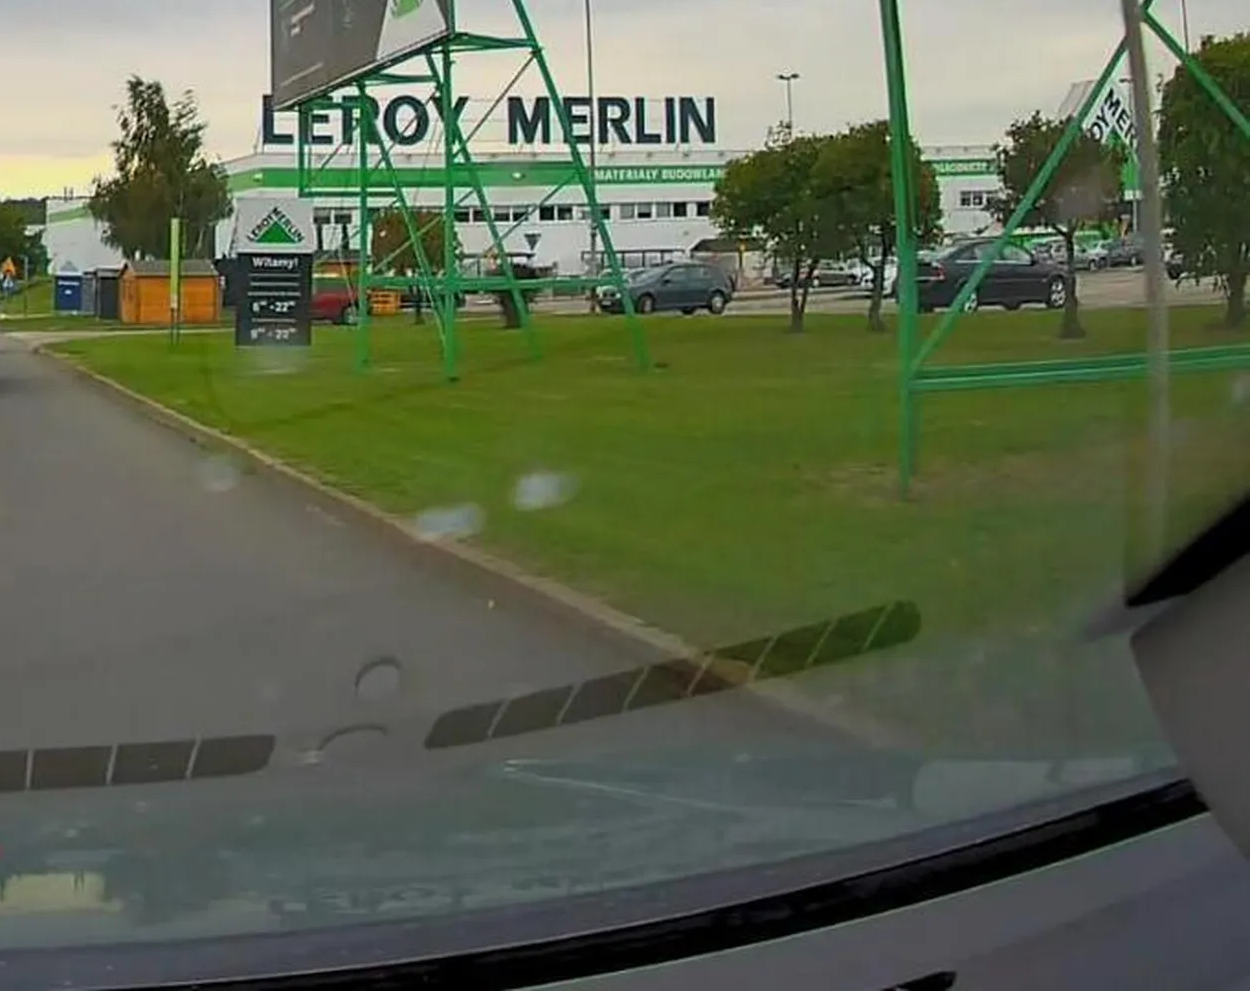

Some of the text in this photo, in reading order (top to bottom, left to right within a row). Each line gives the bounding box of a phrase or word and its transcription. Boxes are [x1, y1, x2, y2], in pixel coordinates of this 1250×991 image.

[262, 95, 717, 146] LEROY MERLIN
[245, 206, 306, 242] LEROY MERLIN
[251, 256, 299, 270] Witamy!
